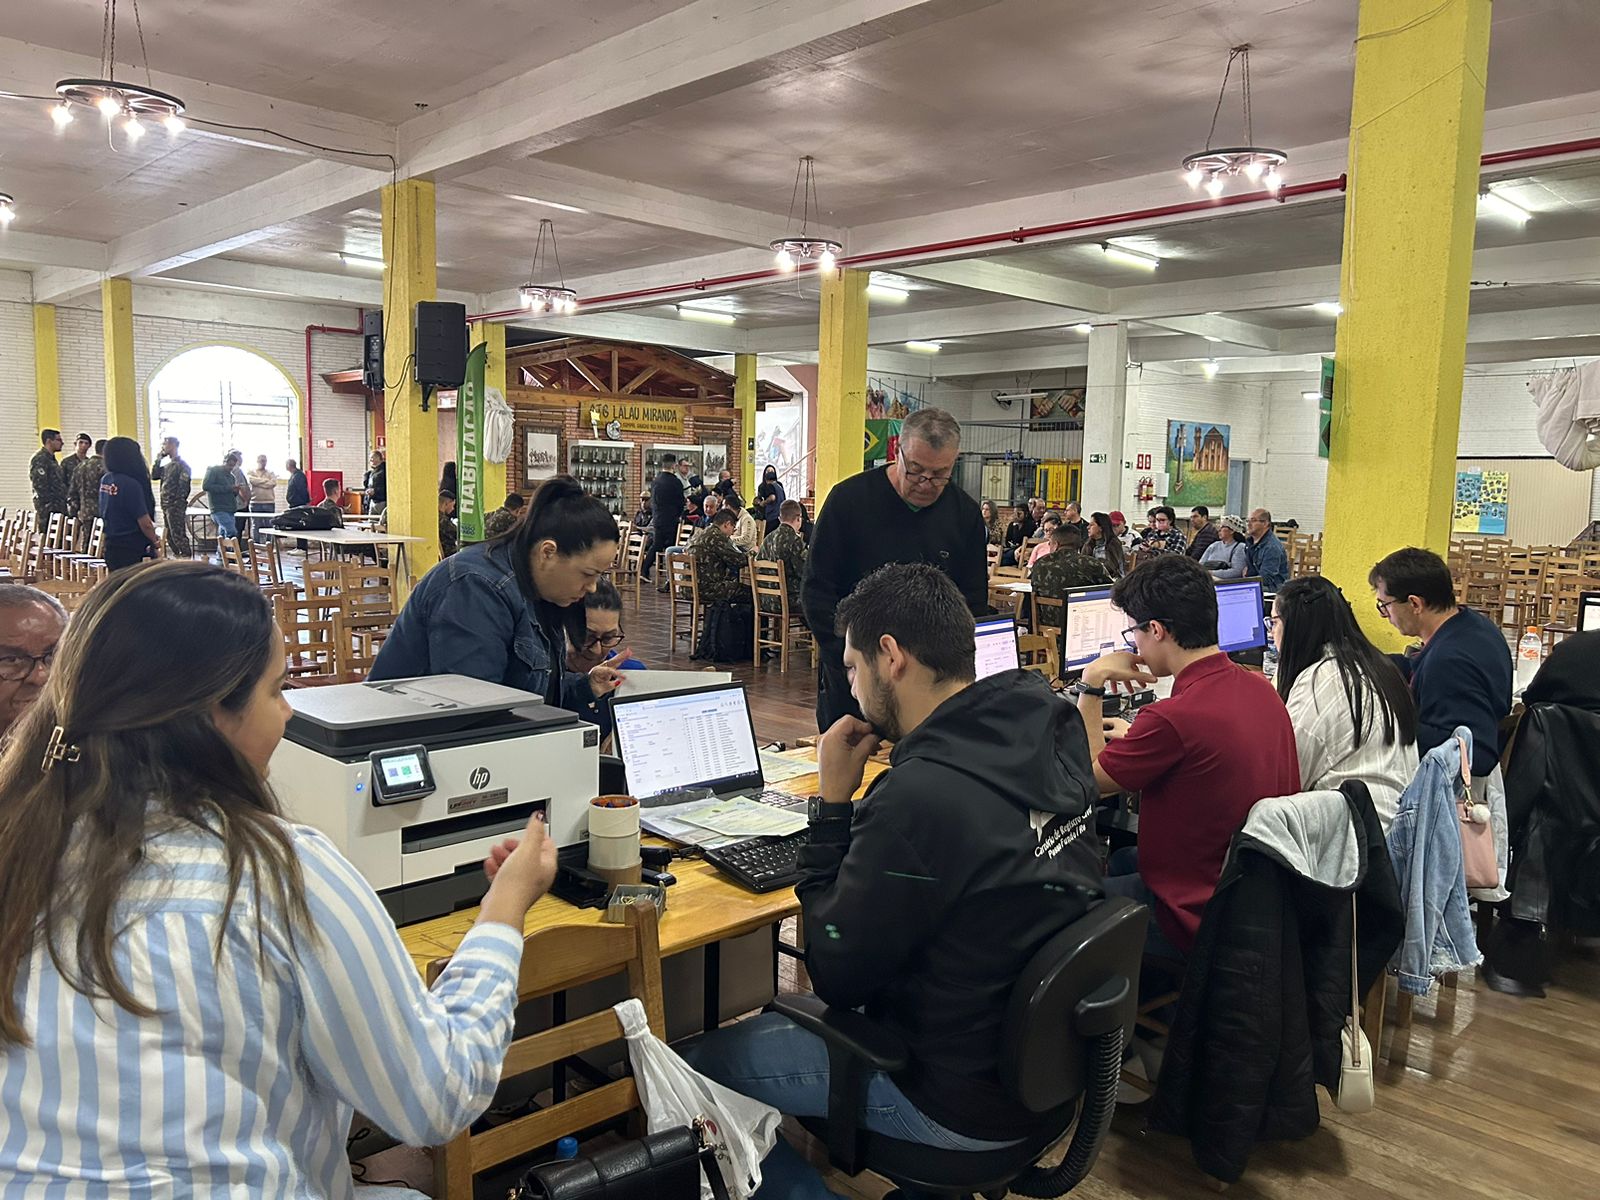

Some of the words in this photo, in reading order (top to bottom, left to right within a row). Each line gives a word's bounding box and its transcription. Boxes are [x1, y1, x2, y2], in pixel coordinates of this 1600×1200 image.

[612, 405, 640, 420] LALAU
[642, 407, 678, 423] MIRANDA
[471, 767, 489, 790] hp
